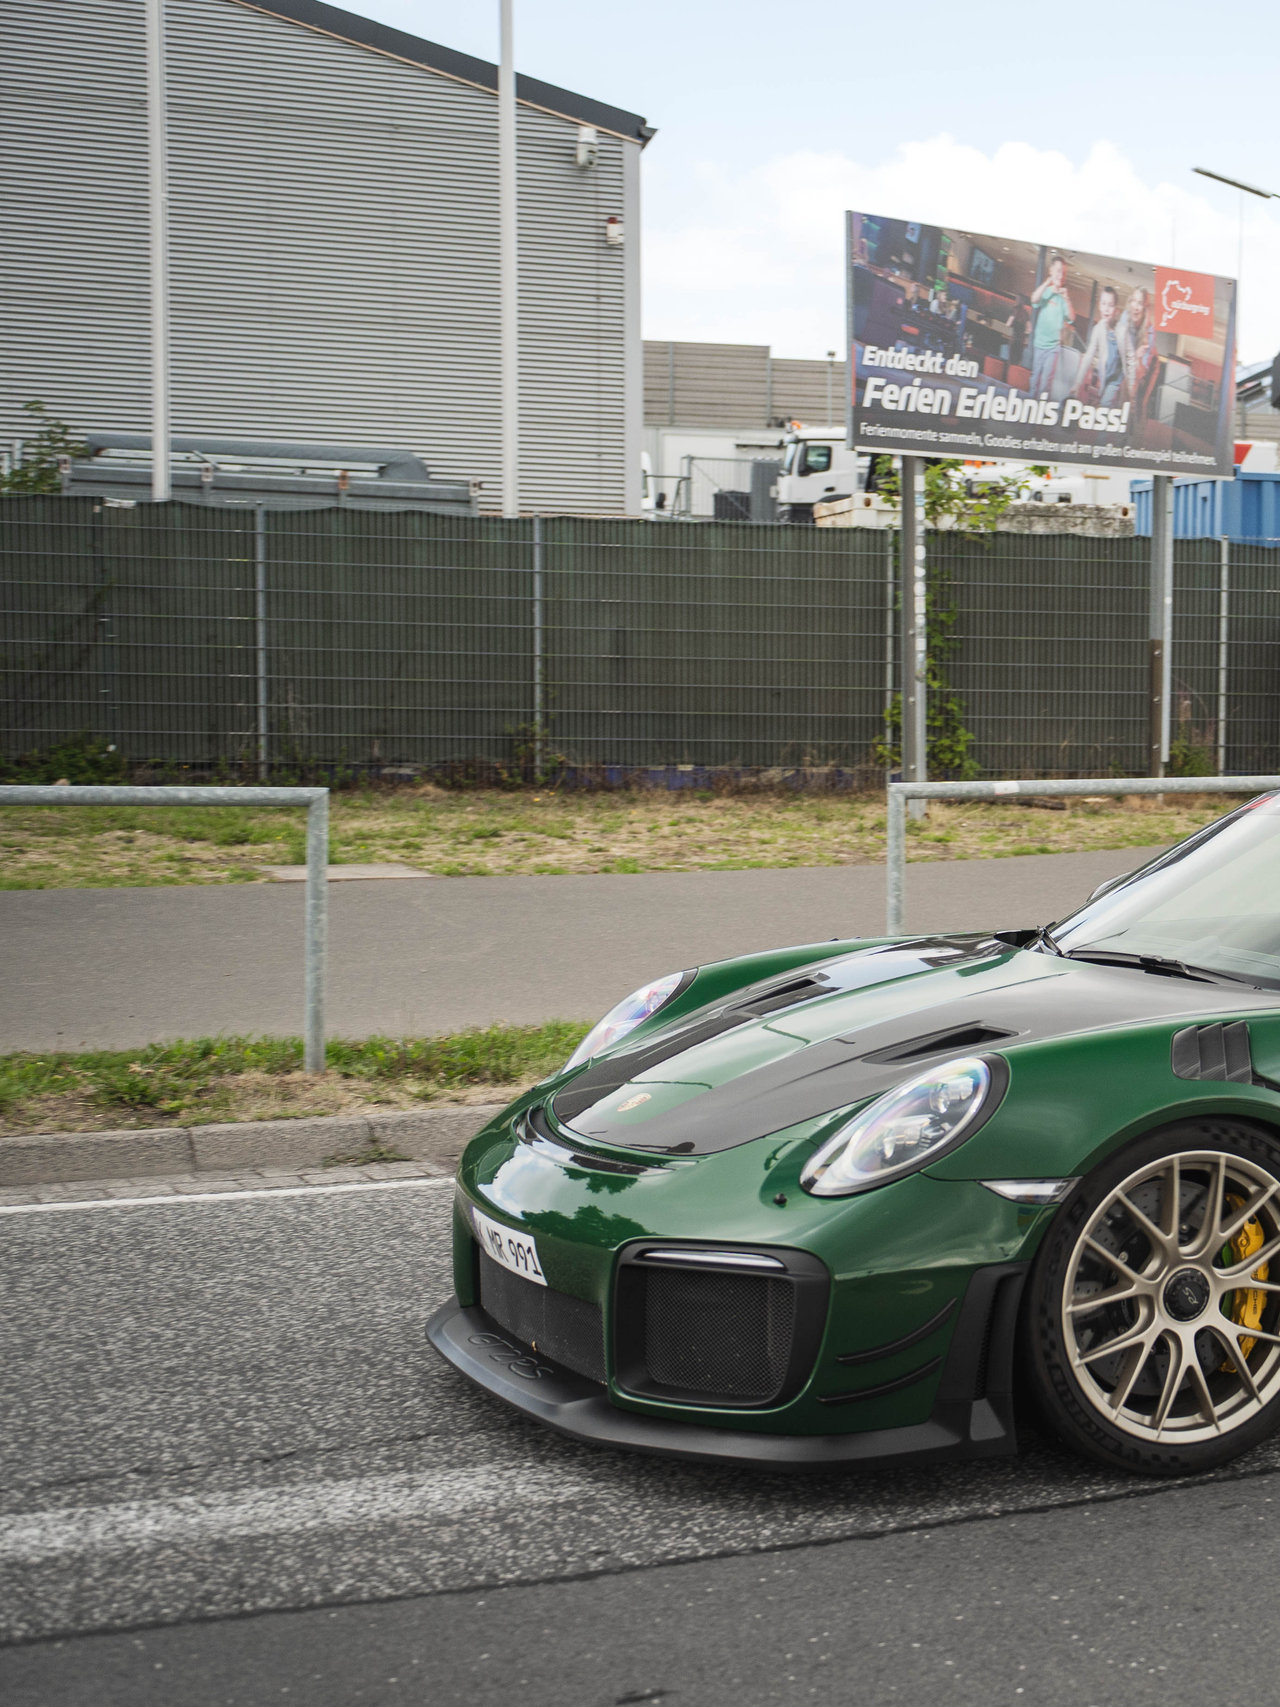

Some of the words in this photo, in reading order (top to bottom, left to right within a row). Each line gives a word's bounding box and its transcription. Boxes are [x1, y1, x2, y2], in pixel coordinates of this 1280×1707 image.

[862, 346, 944, 374] Entdeckt
[945, 354, 979, 378] den
[862, 377, 952, 415] Ferien
[956, 386, 1060, 426] Erlebnis
[1062, 399, 1131, 433] Pass!
[860, 422, 938, 441] Ferienmomente
[939, 432, 983, 447] sammeln,
[984, 434, 1022, 449] Goodies
[1023, 438, 1060, 452] erhalten
[1060, 442, 1078, 453] und
[1078, 444, 1092, 454] am
[1123, 446, 1171, 463] Gewinnspiel
[508, 1238, 542, 1276] 991
